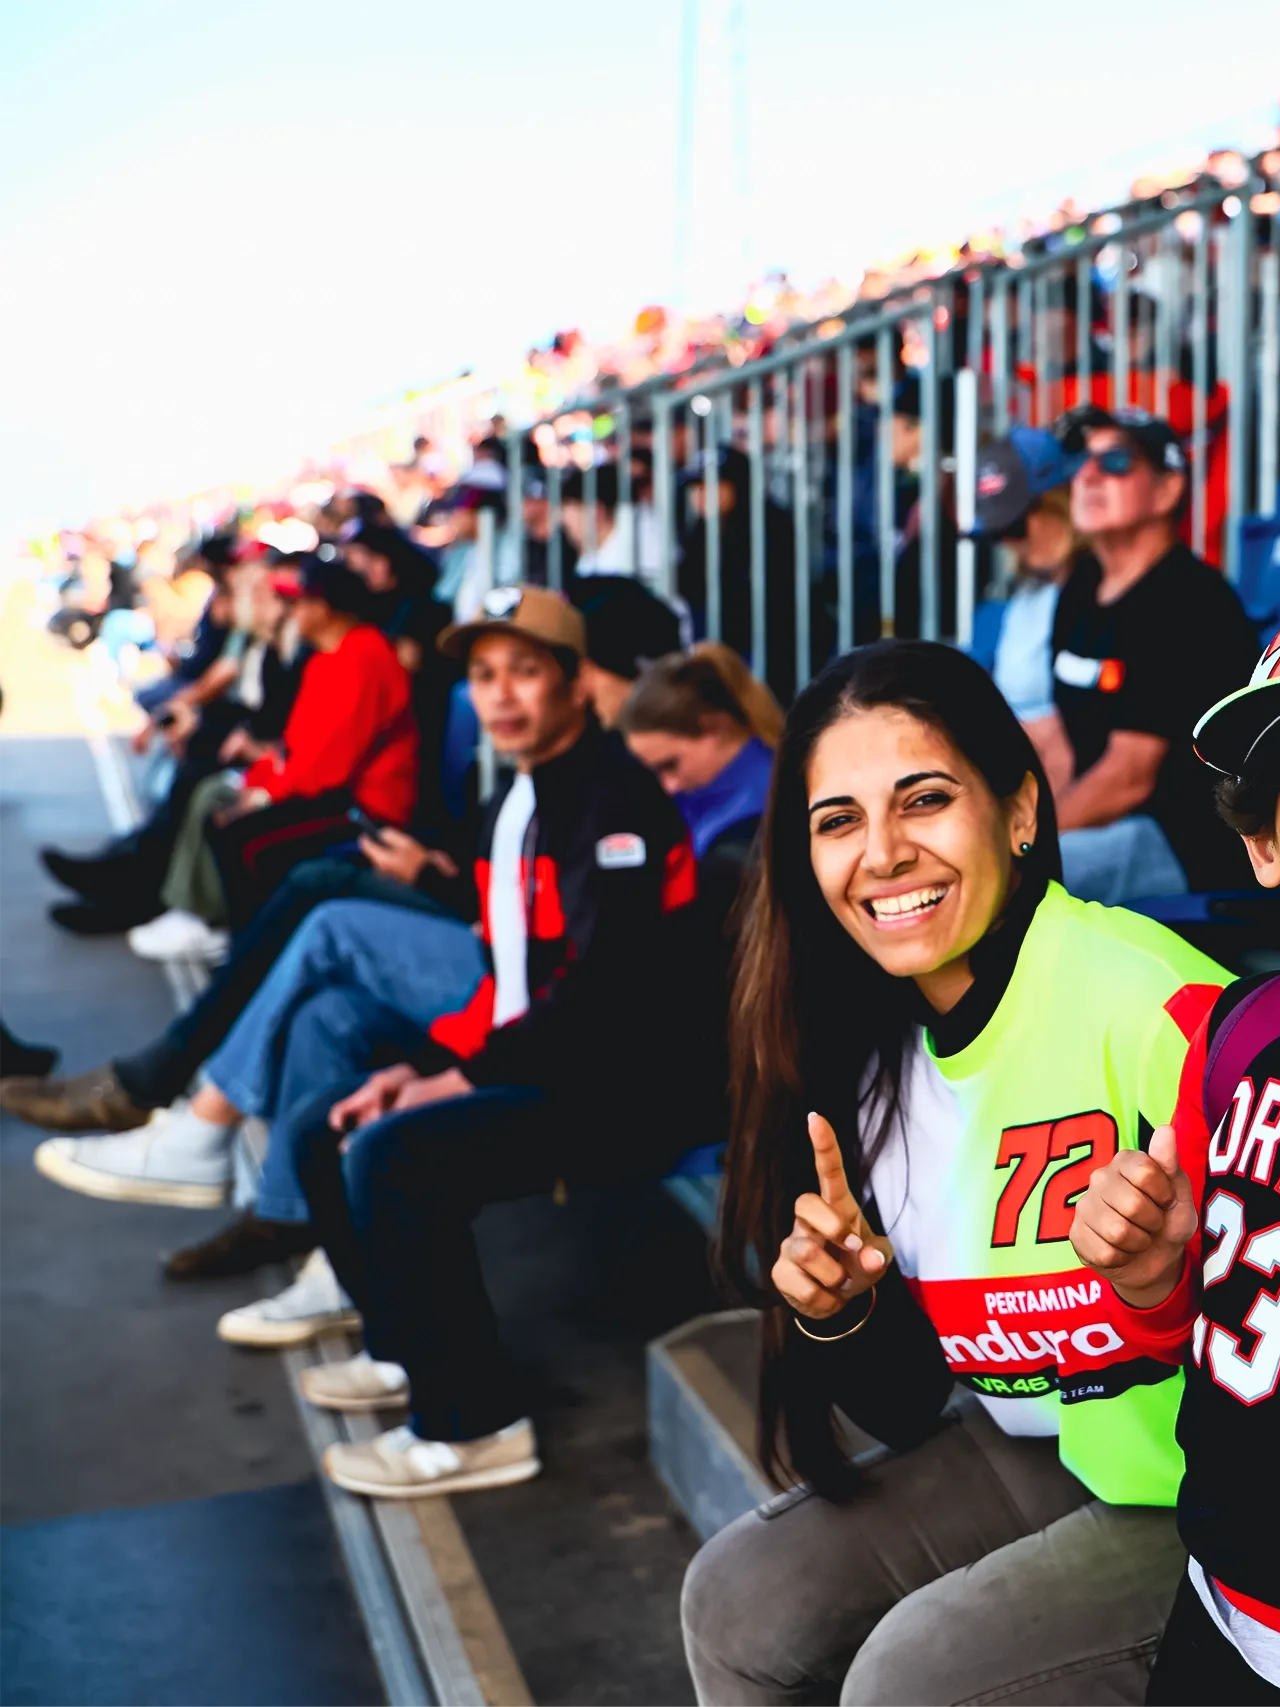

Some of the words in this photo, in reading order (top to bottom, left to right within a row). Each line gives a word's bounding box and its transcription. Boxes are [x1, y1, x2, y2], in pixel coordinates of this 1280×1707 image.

[991, 1109, 1119, 1248] 72
[985, 1280, 1101, 1314] PERTAMINA
[938, 1319, 1125, 1364] ndura
[972, 1376, 1050, 1394] VR46
[1070, 1385, 1104, 1398] TEAM
